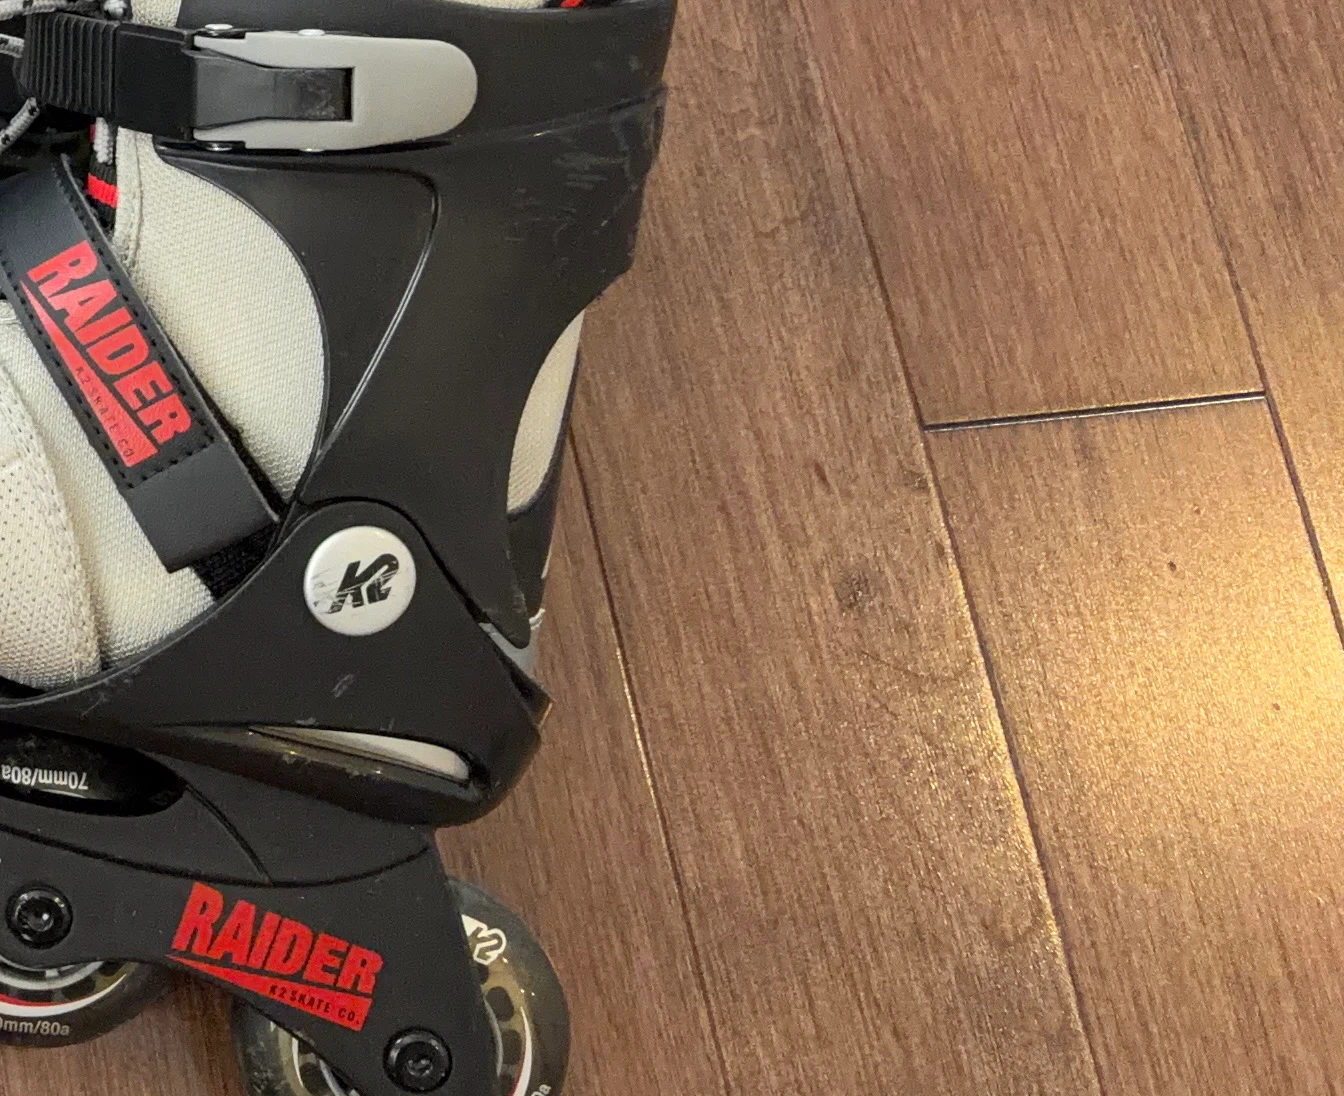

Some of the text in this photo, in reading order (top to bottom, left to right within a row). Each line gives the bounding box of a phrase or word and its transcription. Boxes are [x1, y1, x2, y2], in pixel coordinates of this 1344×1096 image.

[26, 239, 193, 445] RAIDER
[328, 553, 399, 615] K2
[1, 764, 89, 790] 70mm/80a
[170, 881, 384, 995] RAIDER
[269, 984, 361, 1025] K2 SKATE CO.
